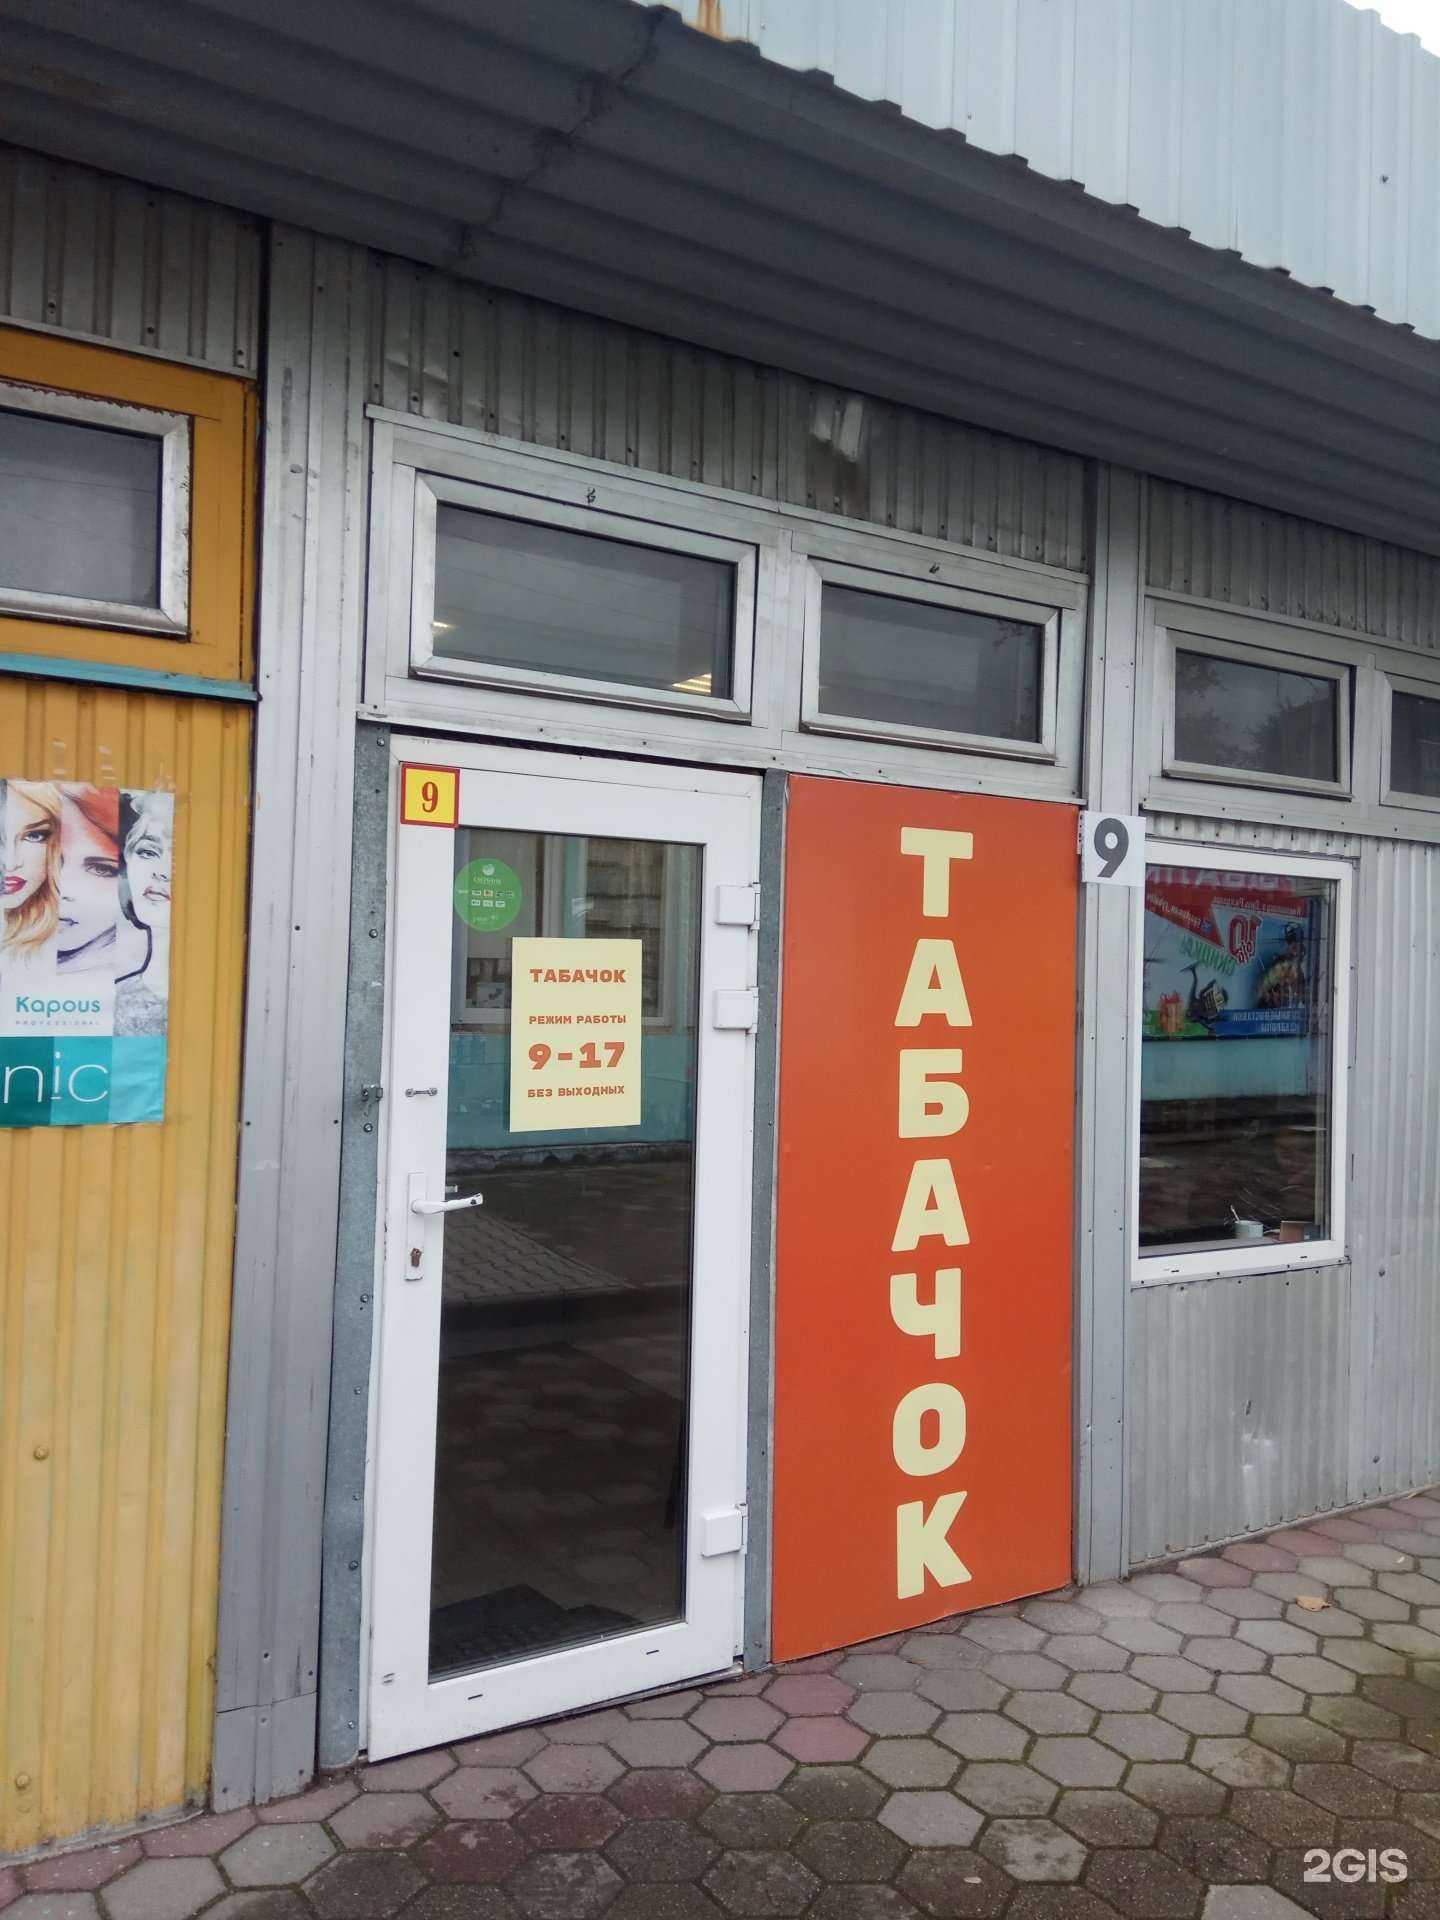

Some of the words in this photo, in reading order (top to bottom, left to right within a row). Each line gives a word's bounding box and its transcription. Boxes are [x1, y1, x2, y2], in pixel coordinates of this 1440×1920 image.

[422, 781, 438, 813] 9
[1093, 817, 1130, 879] 9
[529, 968, 627, 984] ТАБАЧОК
[15, 996, 101, 1018] Kapous
[528, 1015, 573, 1025] РЕЖИМ
[576, 1014, 627, 1025] РАБОТЫ
[528, 1041, 626, 1071] 9-17
[527, 1088, 553, 1099] БЕЗ
[557, 1085, 626, 1098] ВЫХОДНЫХ
[889, 826, 974, 1599] ТАБАЧОК
